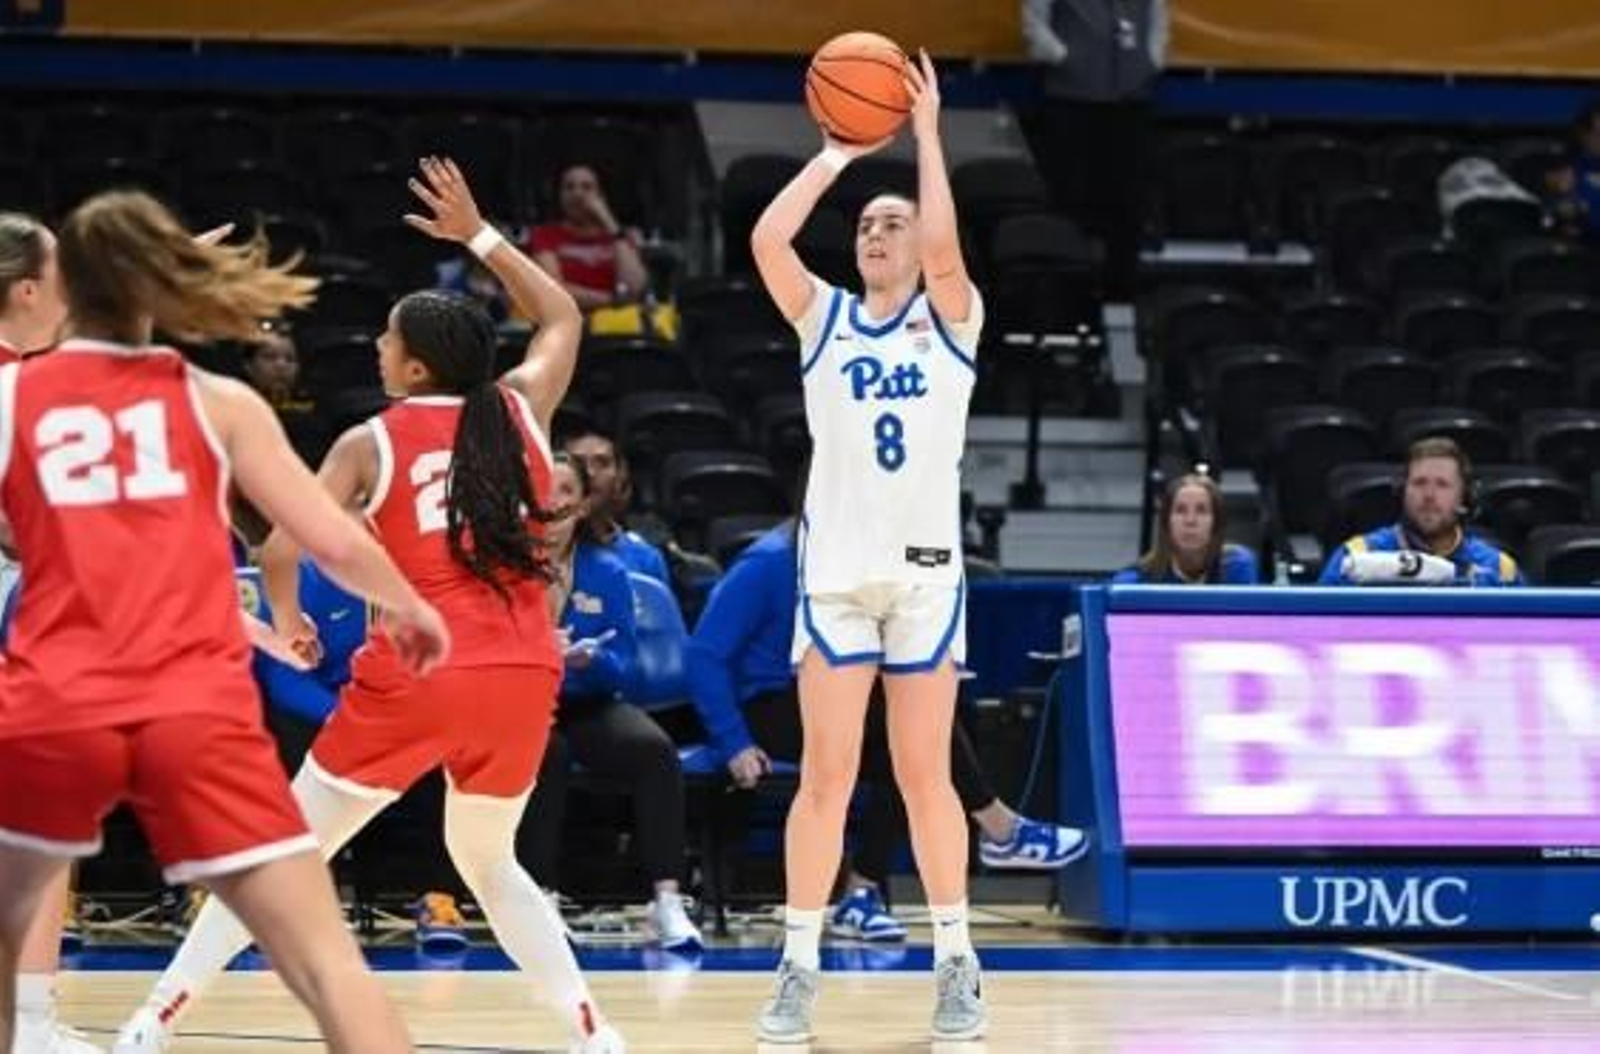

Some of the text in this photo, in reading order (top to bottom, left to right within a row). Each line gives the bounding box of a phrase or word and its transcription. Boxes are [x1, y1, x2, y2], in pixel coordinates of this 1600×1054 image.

[841, 356, 928, 400] Pitt
[34, 399, 189, 506] 21
[874, 412, 906, 472] 8
[1281, 877, 1467, 926] UPMC
